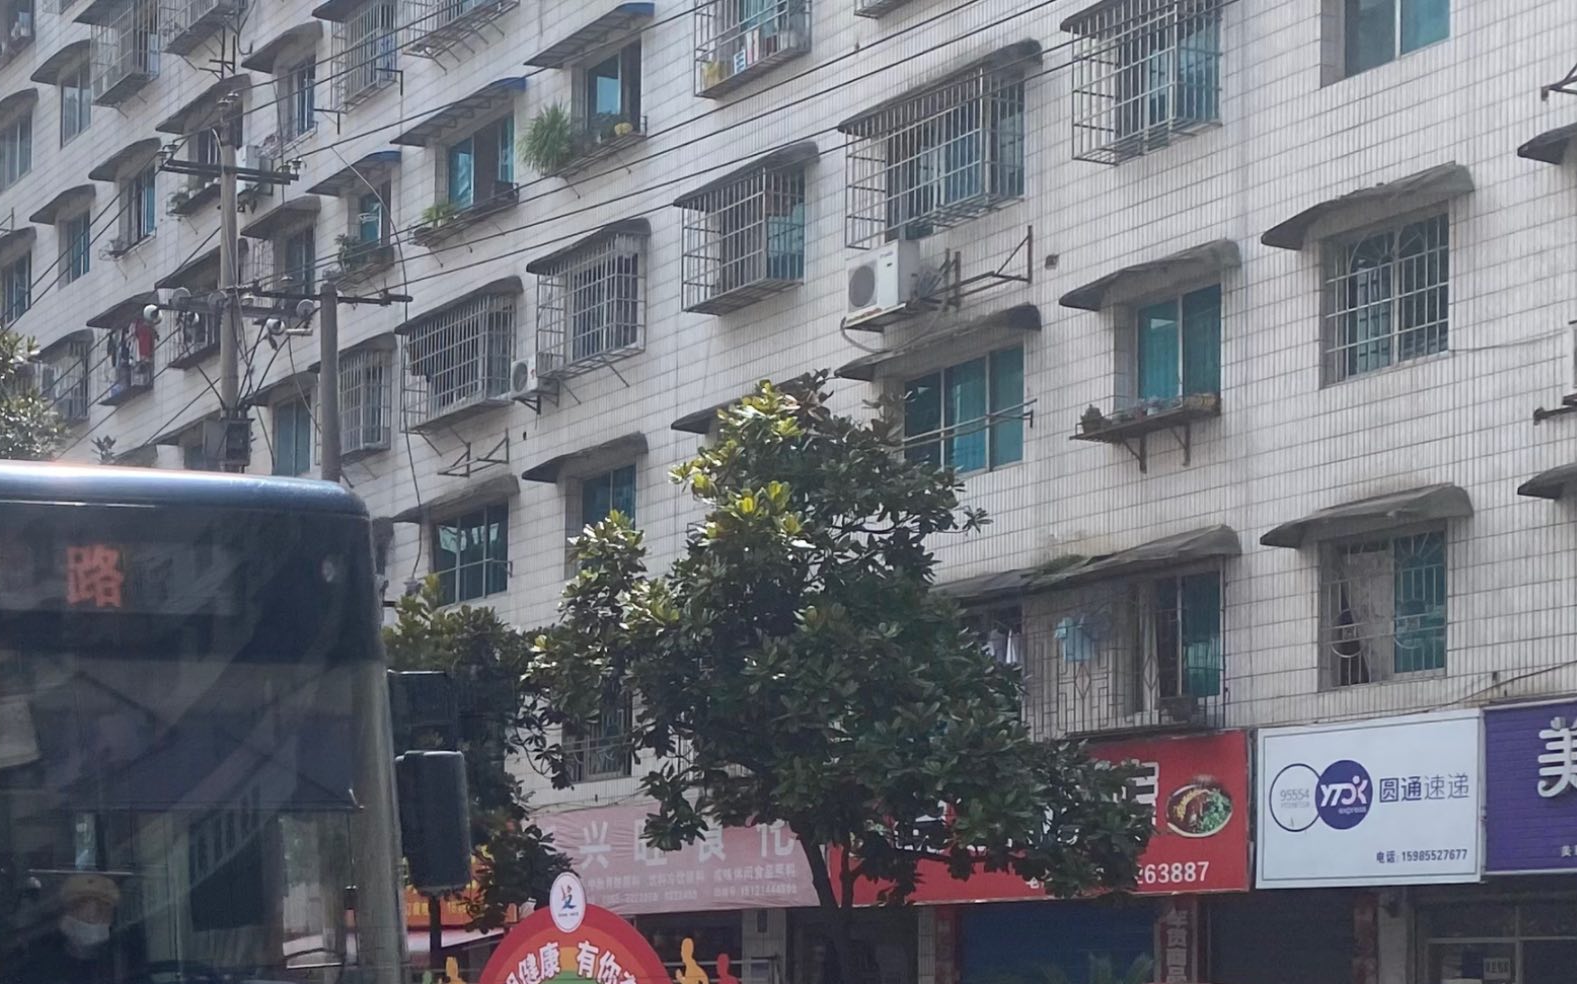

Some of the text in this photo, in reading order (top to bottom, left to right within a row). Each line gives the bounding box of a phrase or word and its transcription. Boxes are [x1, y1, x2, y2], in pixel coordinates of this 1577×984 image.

[66, 543, 125, 608] 路
[1280, 788, 1310, 802] 95554
[1379, 773, 1469, 803] 圆通速递
